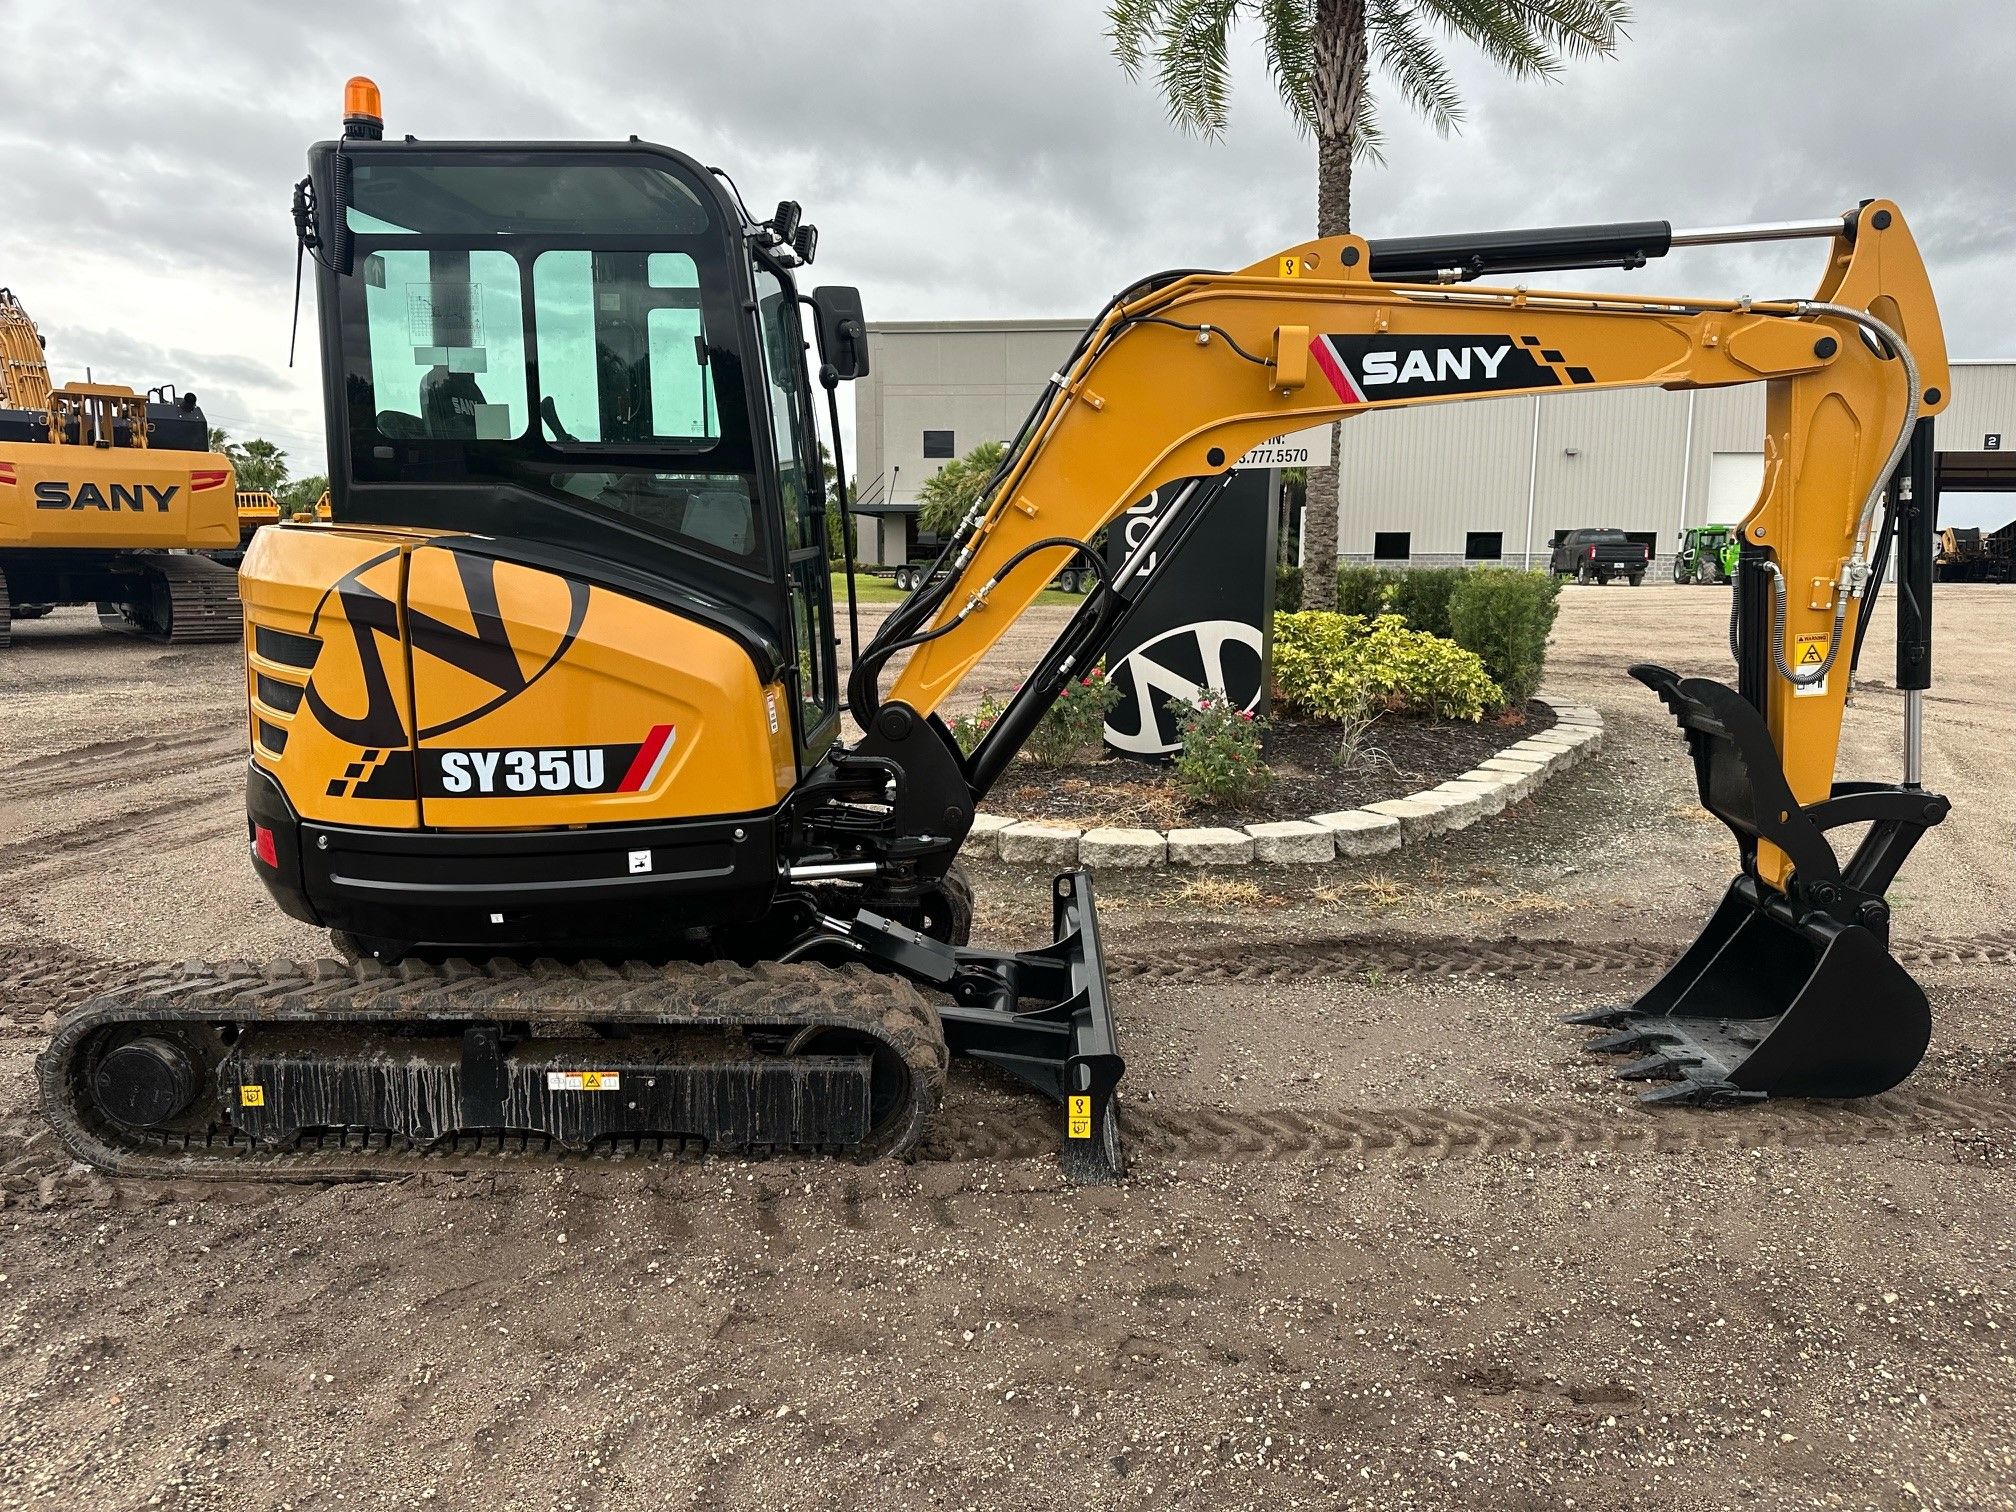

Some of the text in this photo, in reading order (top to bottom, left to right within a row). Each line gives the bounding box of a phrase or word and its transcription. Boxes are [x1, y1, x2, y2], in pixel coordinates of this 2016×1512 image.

[1362, 345, 1512, 386] SANY
[1987, 436, 1997, 446] 2
[34, 481, 181, 512] SANY
[441, 749, 605, 793] SY35U
